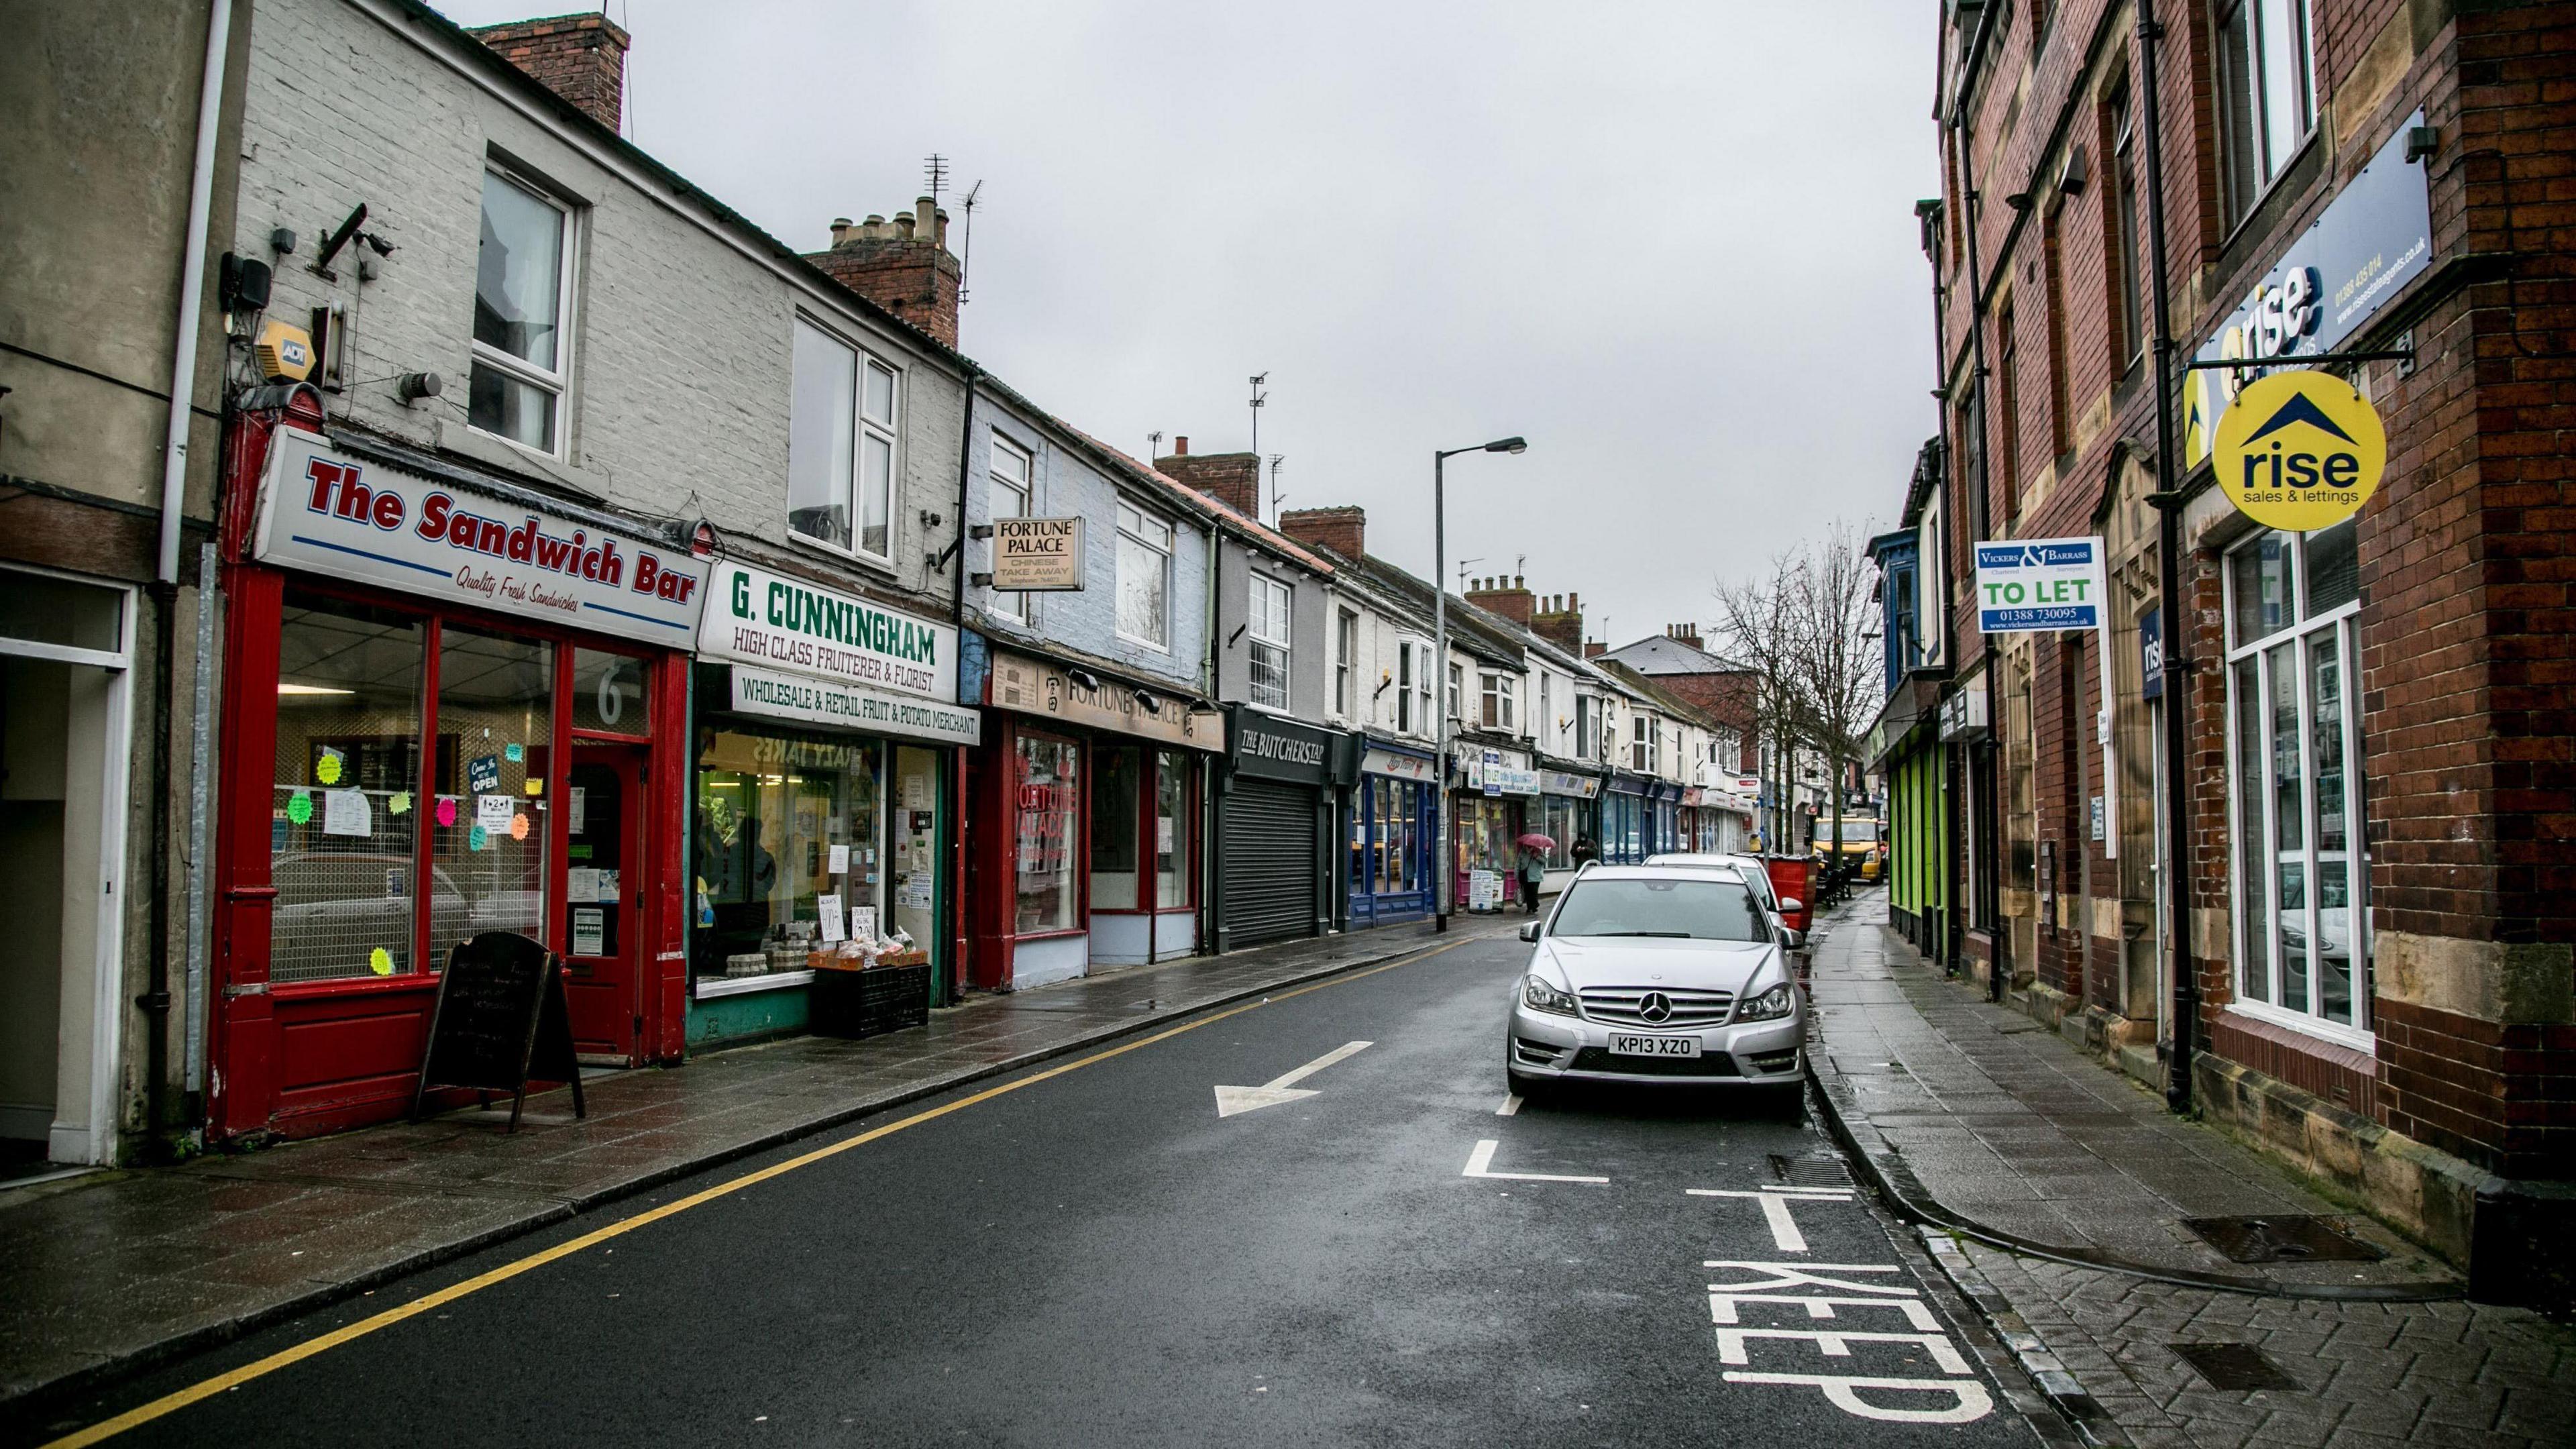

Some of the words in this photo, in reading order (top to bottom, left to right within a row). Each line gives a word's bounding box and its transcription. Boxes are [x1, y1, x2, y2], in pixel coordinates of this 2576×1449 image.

[2336, 279, 2354, 307] 01388
[2355, 266, 2367, 288] 435
[2369, 253, 2382, 276] 014
[2337, 237, 2426, 325] www.riseestateagents.co.uk
[2242, 267, 2310, 381] rise
[283, 345, 306, 362] ADT
[2244, 441, 2359, 488] rise
[2244, 490, 2282, 502] sales
[2288, 490, 2298, 502] &
[2304, 490, 2359, 505] lettings
[306, 455, 406, 531] The
[415, 491, 624, 588] Sandwich
[631, 550, 698, 606] Bar
[1000, 521, 1072, 537] FORTUNE
[1008, 538, 1063, 553] PALACE
[2020, 544, 2047, 568] &
[1000, 568, 1030, 576] TAKE
[1034, 568, 1069, 576] AWAY
[1011, 558, 1059, 566] CHINESE
[456, 566, 496, 598] Quality
[499, 576, 527, 600] Fresh
[529, 583, 578, 612] Sandwiches
[1983, 582, 2025, 605] TO
[2036, 579, 2090, 603] LET
[732, 571, 756, 621] G.
[767, 581, 936, 666] CUNNINGHAM
[1990, 618, 2088, 629] www.vickersandbarrass.co.uk
[2000, 610, 2033, 621] 01388
[2037, 608, 2077, 619] 730095
[733, 627, 769, 655] HIGH
[771, 636, 812, 665] CLASS
[818, 646, 881, 681] FRUITERER
[885, 665, 892, 682] &
[894, 665, 934, 692] FLORIST
[598, 665, 622, 724] 6
[743, 678, 812, 710] WHOLESALE
[815, 692, 822, 710] &
[826, 692, 860, 718] RETAIL
[863, 698, 890, 722] FRUIT
[892, 704, 898, 722] &
[900, 705, 930, 727] POTATO
[932, 711, 975, 735] MERCHANT
[1069, 678, 1129, 714] FORTUNE
[1138, 698, 1178, 725] PACE
[1242, 729, 1258, 748] THE
[1257, 733, 1311, 764] BUTCHERS
[1310, 743, 1324, 759] TAP
[472, 761, 486, 775] Come
[473, 775, 498, 792] OPEN
[494, 799, 498, 808] 2
[1016, 784, 1076, 812] ORTUNE
[1016, 811, 1065, 837] ALACE
[1618, 1037, 1654, 1053] KP13
[1659, 1039, 1690, 1055] XZO
[1703, 1260, 1994, 1424] KEEP
